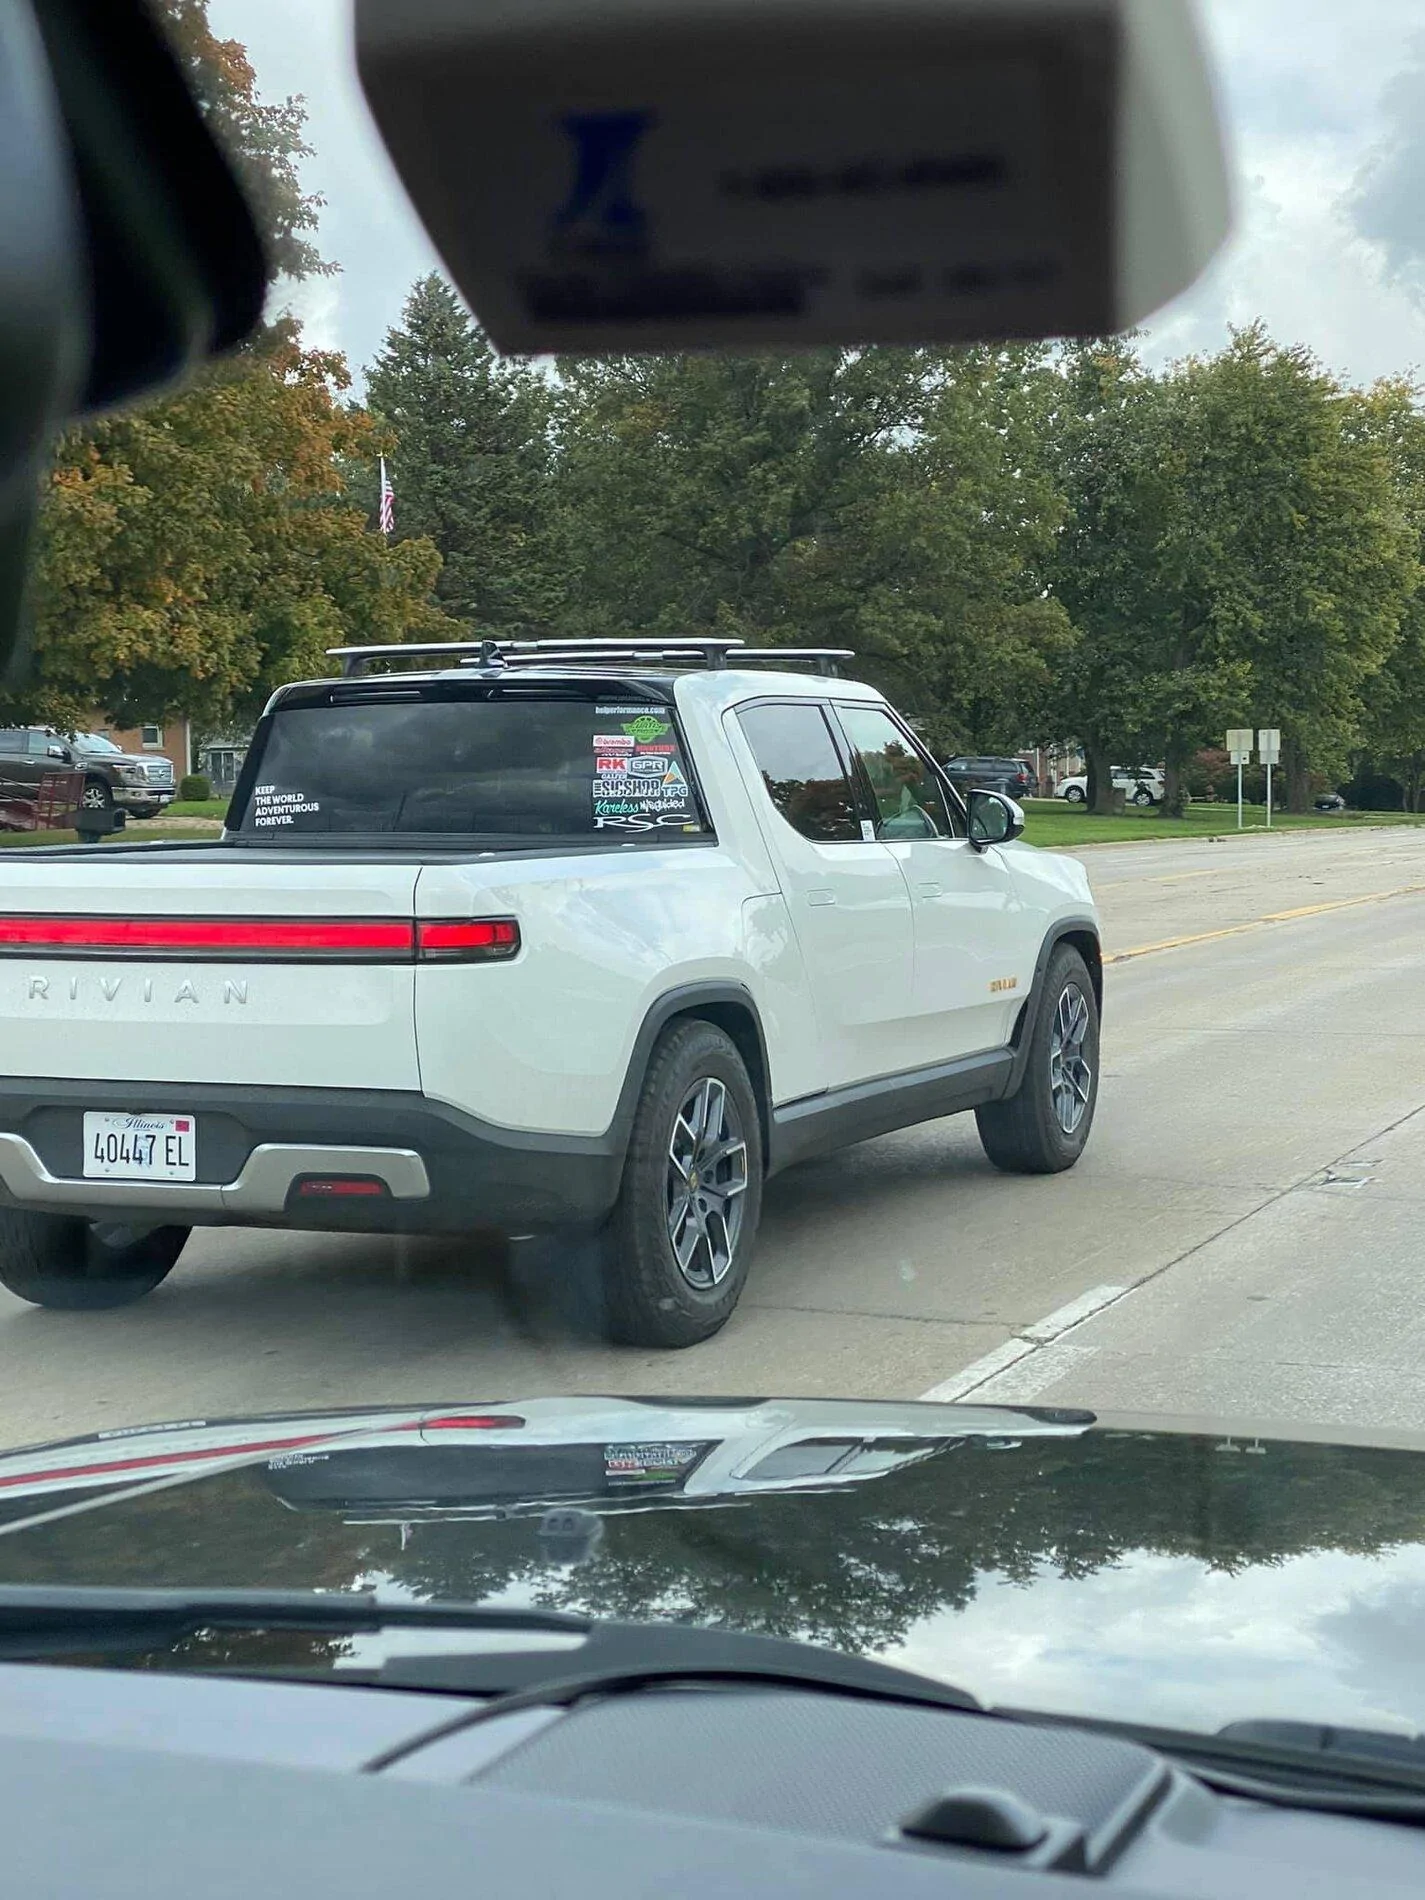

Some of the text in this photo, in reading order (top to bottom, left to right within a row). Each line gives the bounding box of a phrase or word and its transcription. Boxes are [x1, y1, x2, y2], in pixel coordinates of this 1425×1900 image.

[598, 758, 625, 770] RK
[632, 760, 663, 770] GPR
[255, 785, 275, 795] KEEP
[662, 786, 688, 797] TPG
[255, 793, 304, 806] THE WORLD
[255, 802, 319, 816] ADVENTUROUS
[593, 799, 639, 815] Kareless
[255, 815, 294, 827] FOREVER.
[593, 813, 694, 833] RSC
[28, 975, 248, 1004] RIVIAN
[121, 1117, 166, 1129] Illinois
[94, 1132, 190, 1167] 40447 EL
